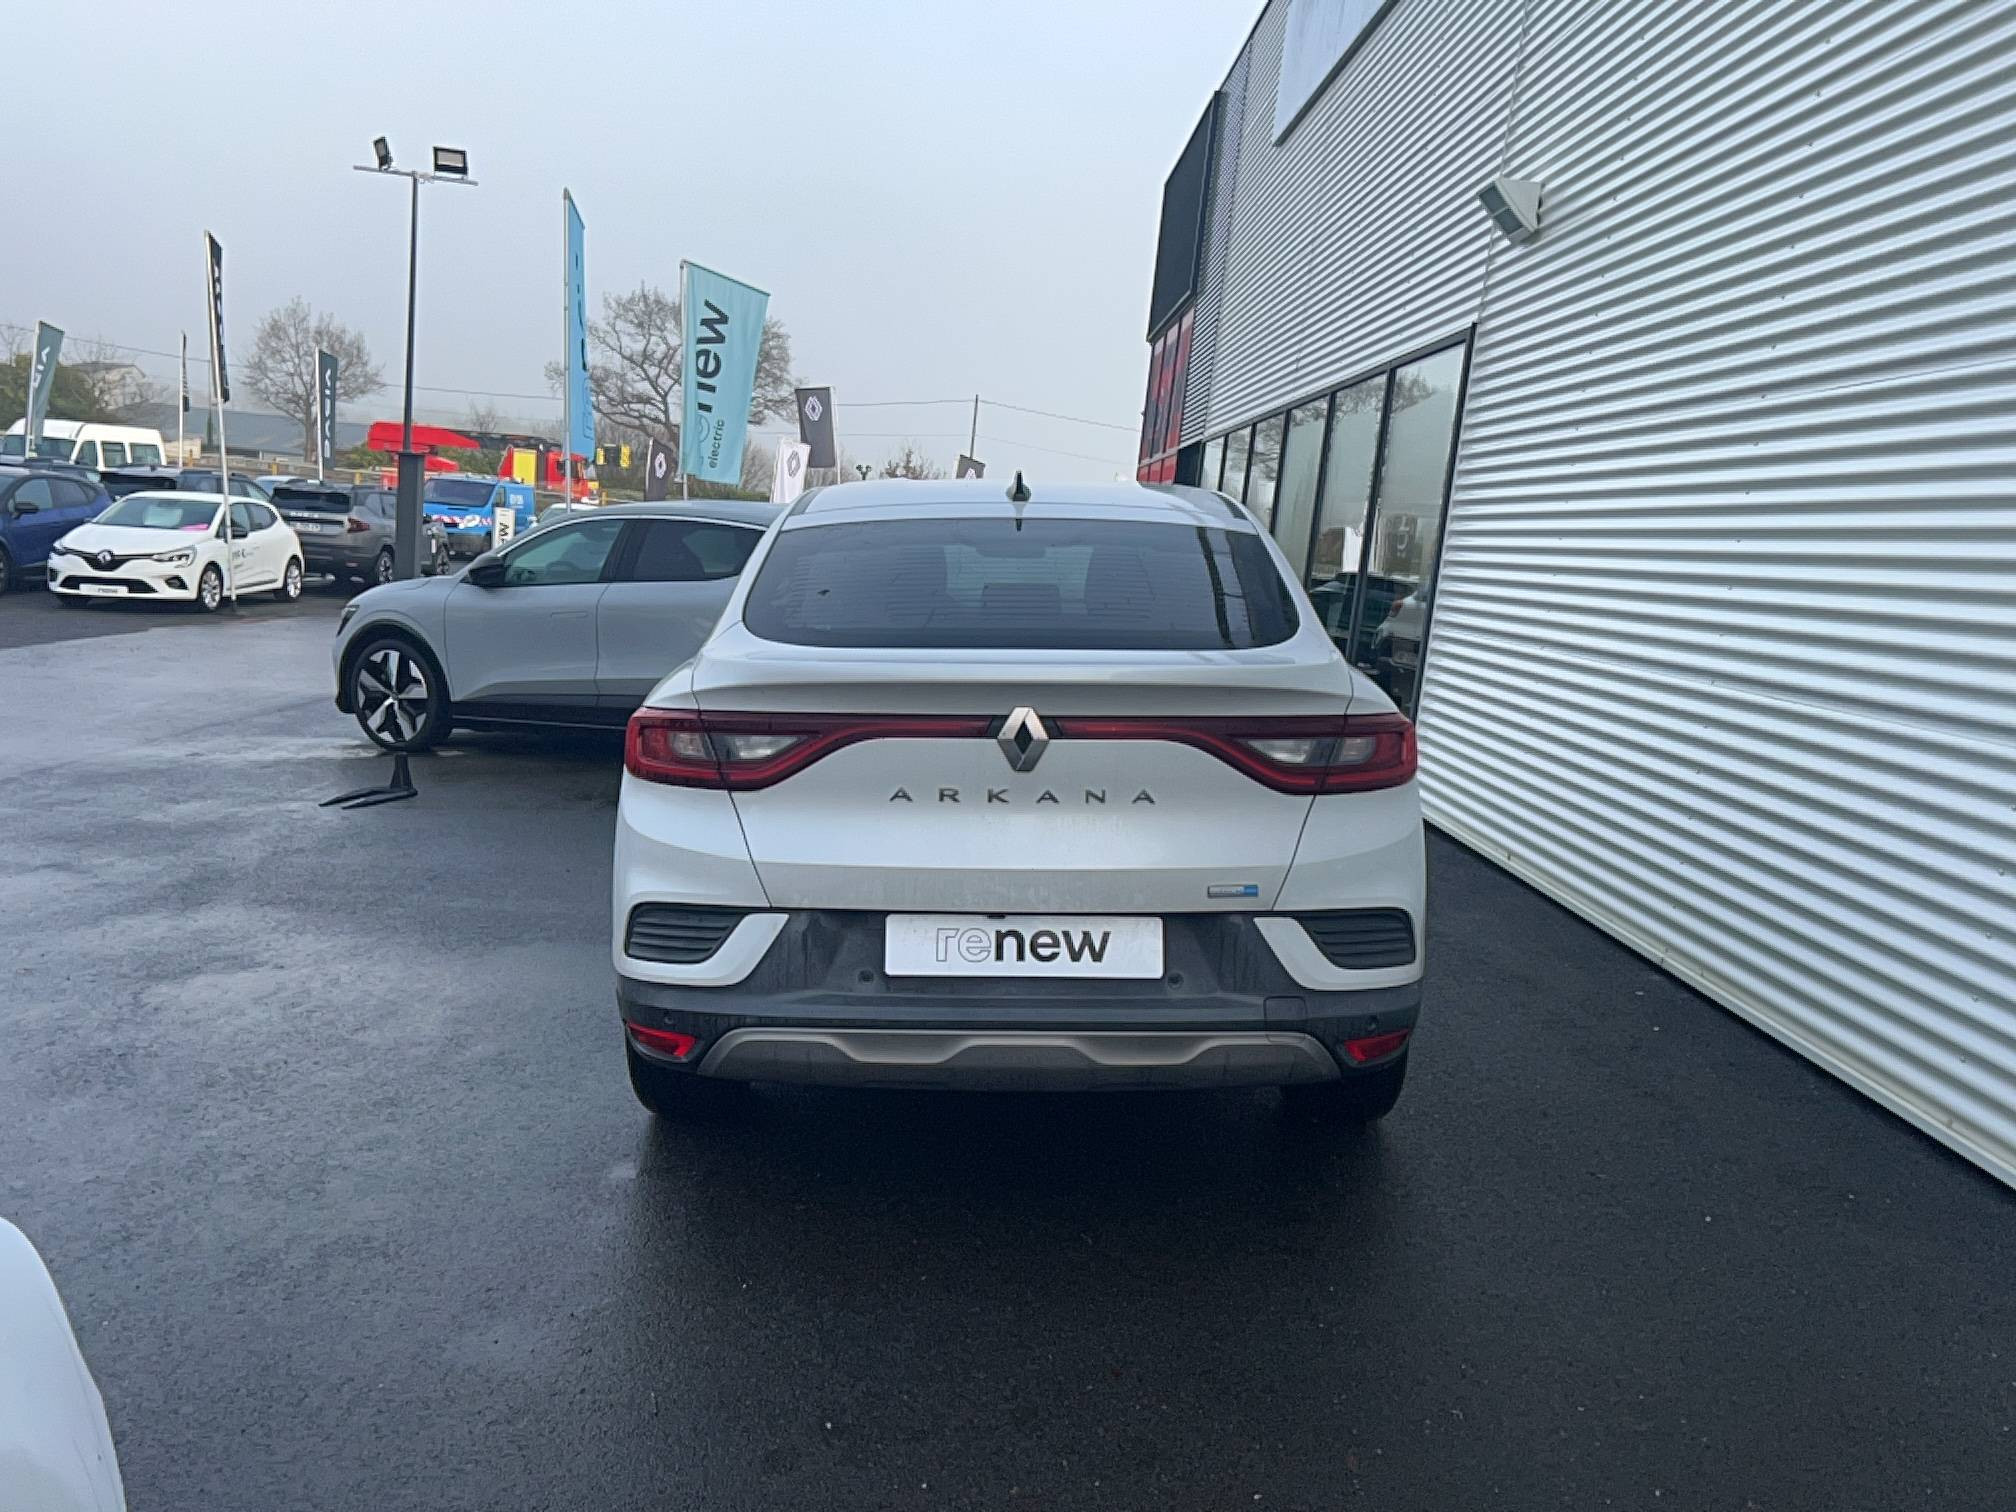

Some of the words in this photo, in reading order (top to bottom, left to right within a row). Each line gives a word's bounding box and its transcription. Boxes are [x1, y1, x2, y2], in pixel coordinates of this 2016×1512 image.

[708, 418, 725, 469] electric
[889, 786, 1156, 804] ARKANA
[935, 927, 1113, 964] renew
